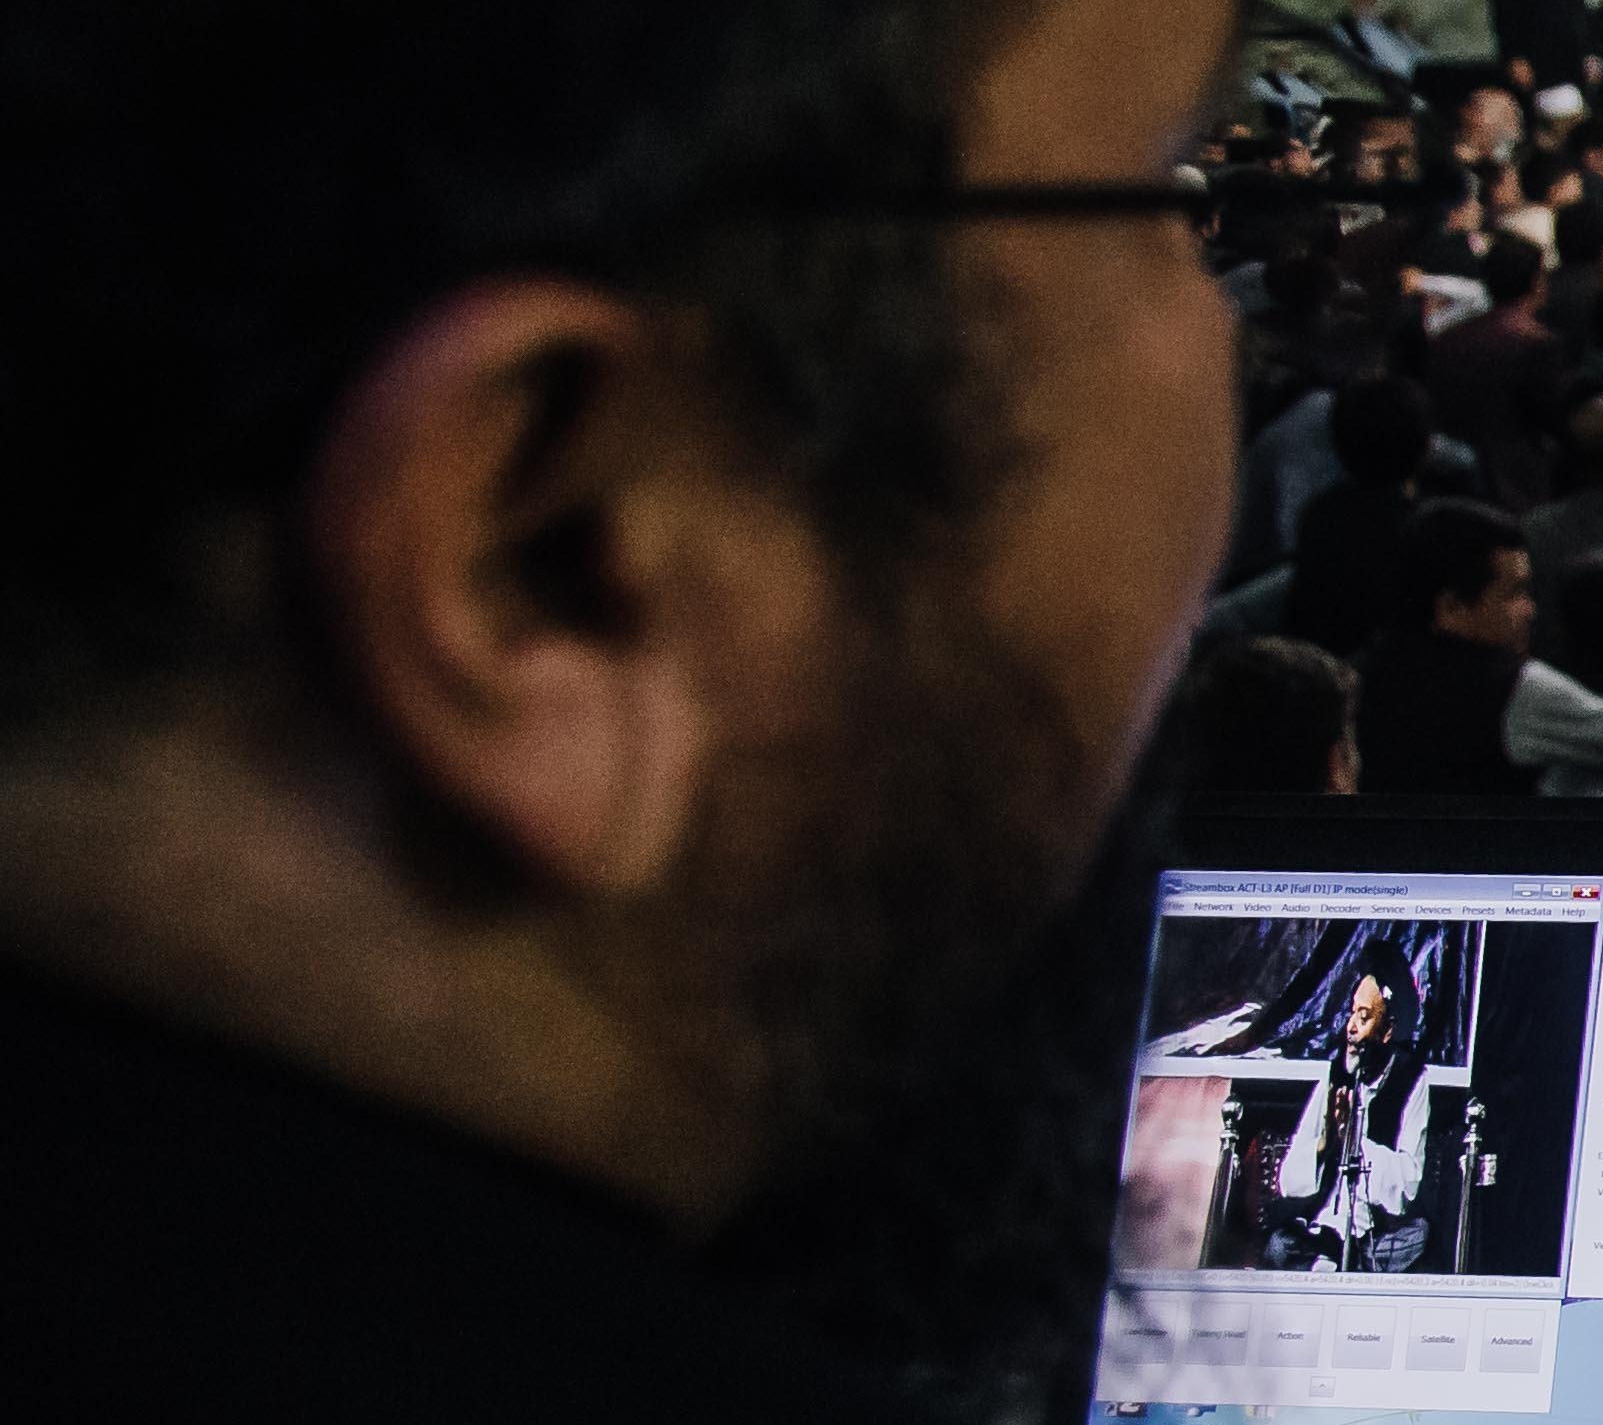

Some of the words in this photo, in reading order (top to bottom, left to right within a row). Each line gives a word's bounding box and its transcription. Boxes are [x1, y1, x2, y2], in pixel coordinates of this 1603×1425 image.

[1184, 882, 1236, 895] Streambox
[1274, 883, 1289, 895] AP
[1345, 884, 1408, 897] mode(single)
[1194, 902, 1233, 912] Network
[1244, 902, 1272, 913] Video
[1281, 903, 1311, 913] Audio
[1320, 903, 1361, 914] Decoder
[1371, 904, 1406, 914] Service
[1415, 905, 1452, 915] Devices
[1462, 906, 1496, 916] Presets
[1505, 906, 1552, 916] Metadata
[1562, 907, 1586, 918] Help
[1277, 1331, 1304, 1341] Action
[1347, 1332, 1381, 1344] Reliable
[1421, 1334, 1456, 1345] Satellite
[1491, 1336, 1533, 1347] Advanced
